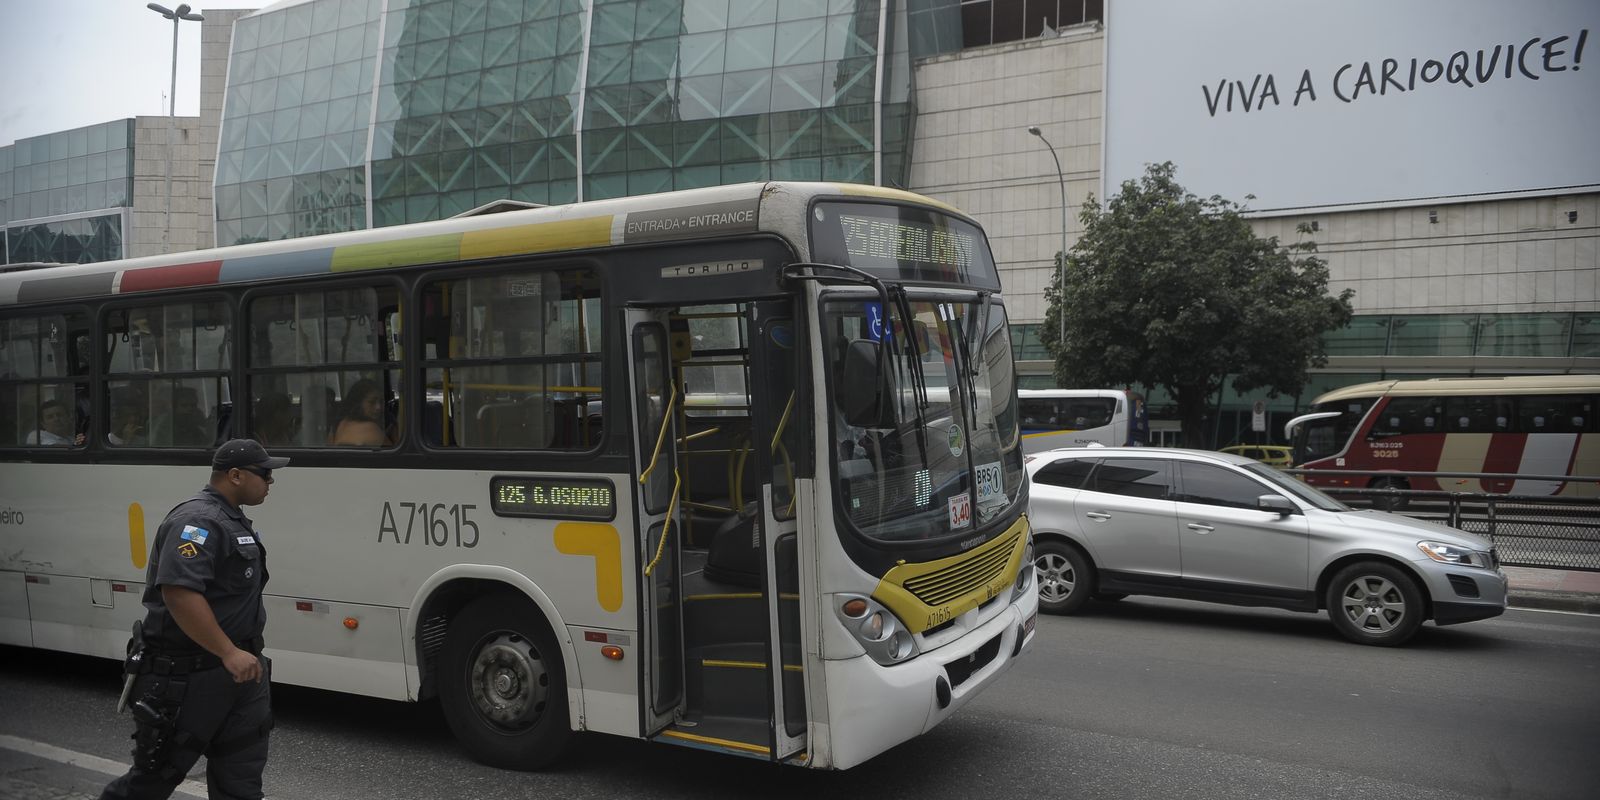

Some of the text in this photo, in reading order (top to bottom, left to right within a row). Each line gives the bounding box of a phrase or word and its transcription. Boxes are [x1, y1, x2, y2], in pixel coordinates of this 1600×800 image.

[1202, 29, 1589, 117] VIVA A CARIOQUICE!
[627, 209, 754, 234] ENTRADA ENTRANCE
[674, 261, 750, 276] TORINO
[976, 467, 992, 485] BRS
[499, 485, 526, 504] 125
[377, 500, 480, 549] A71615
[951, 502, 970, 526] 3,40
[926, 606, 951, 629] A71615
